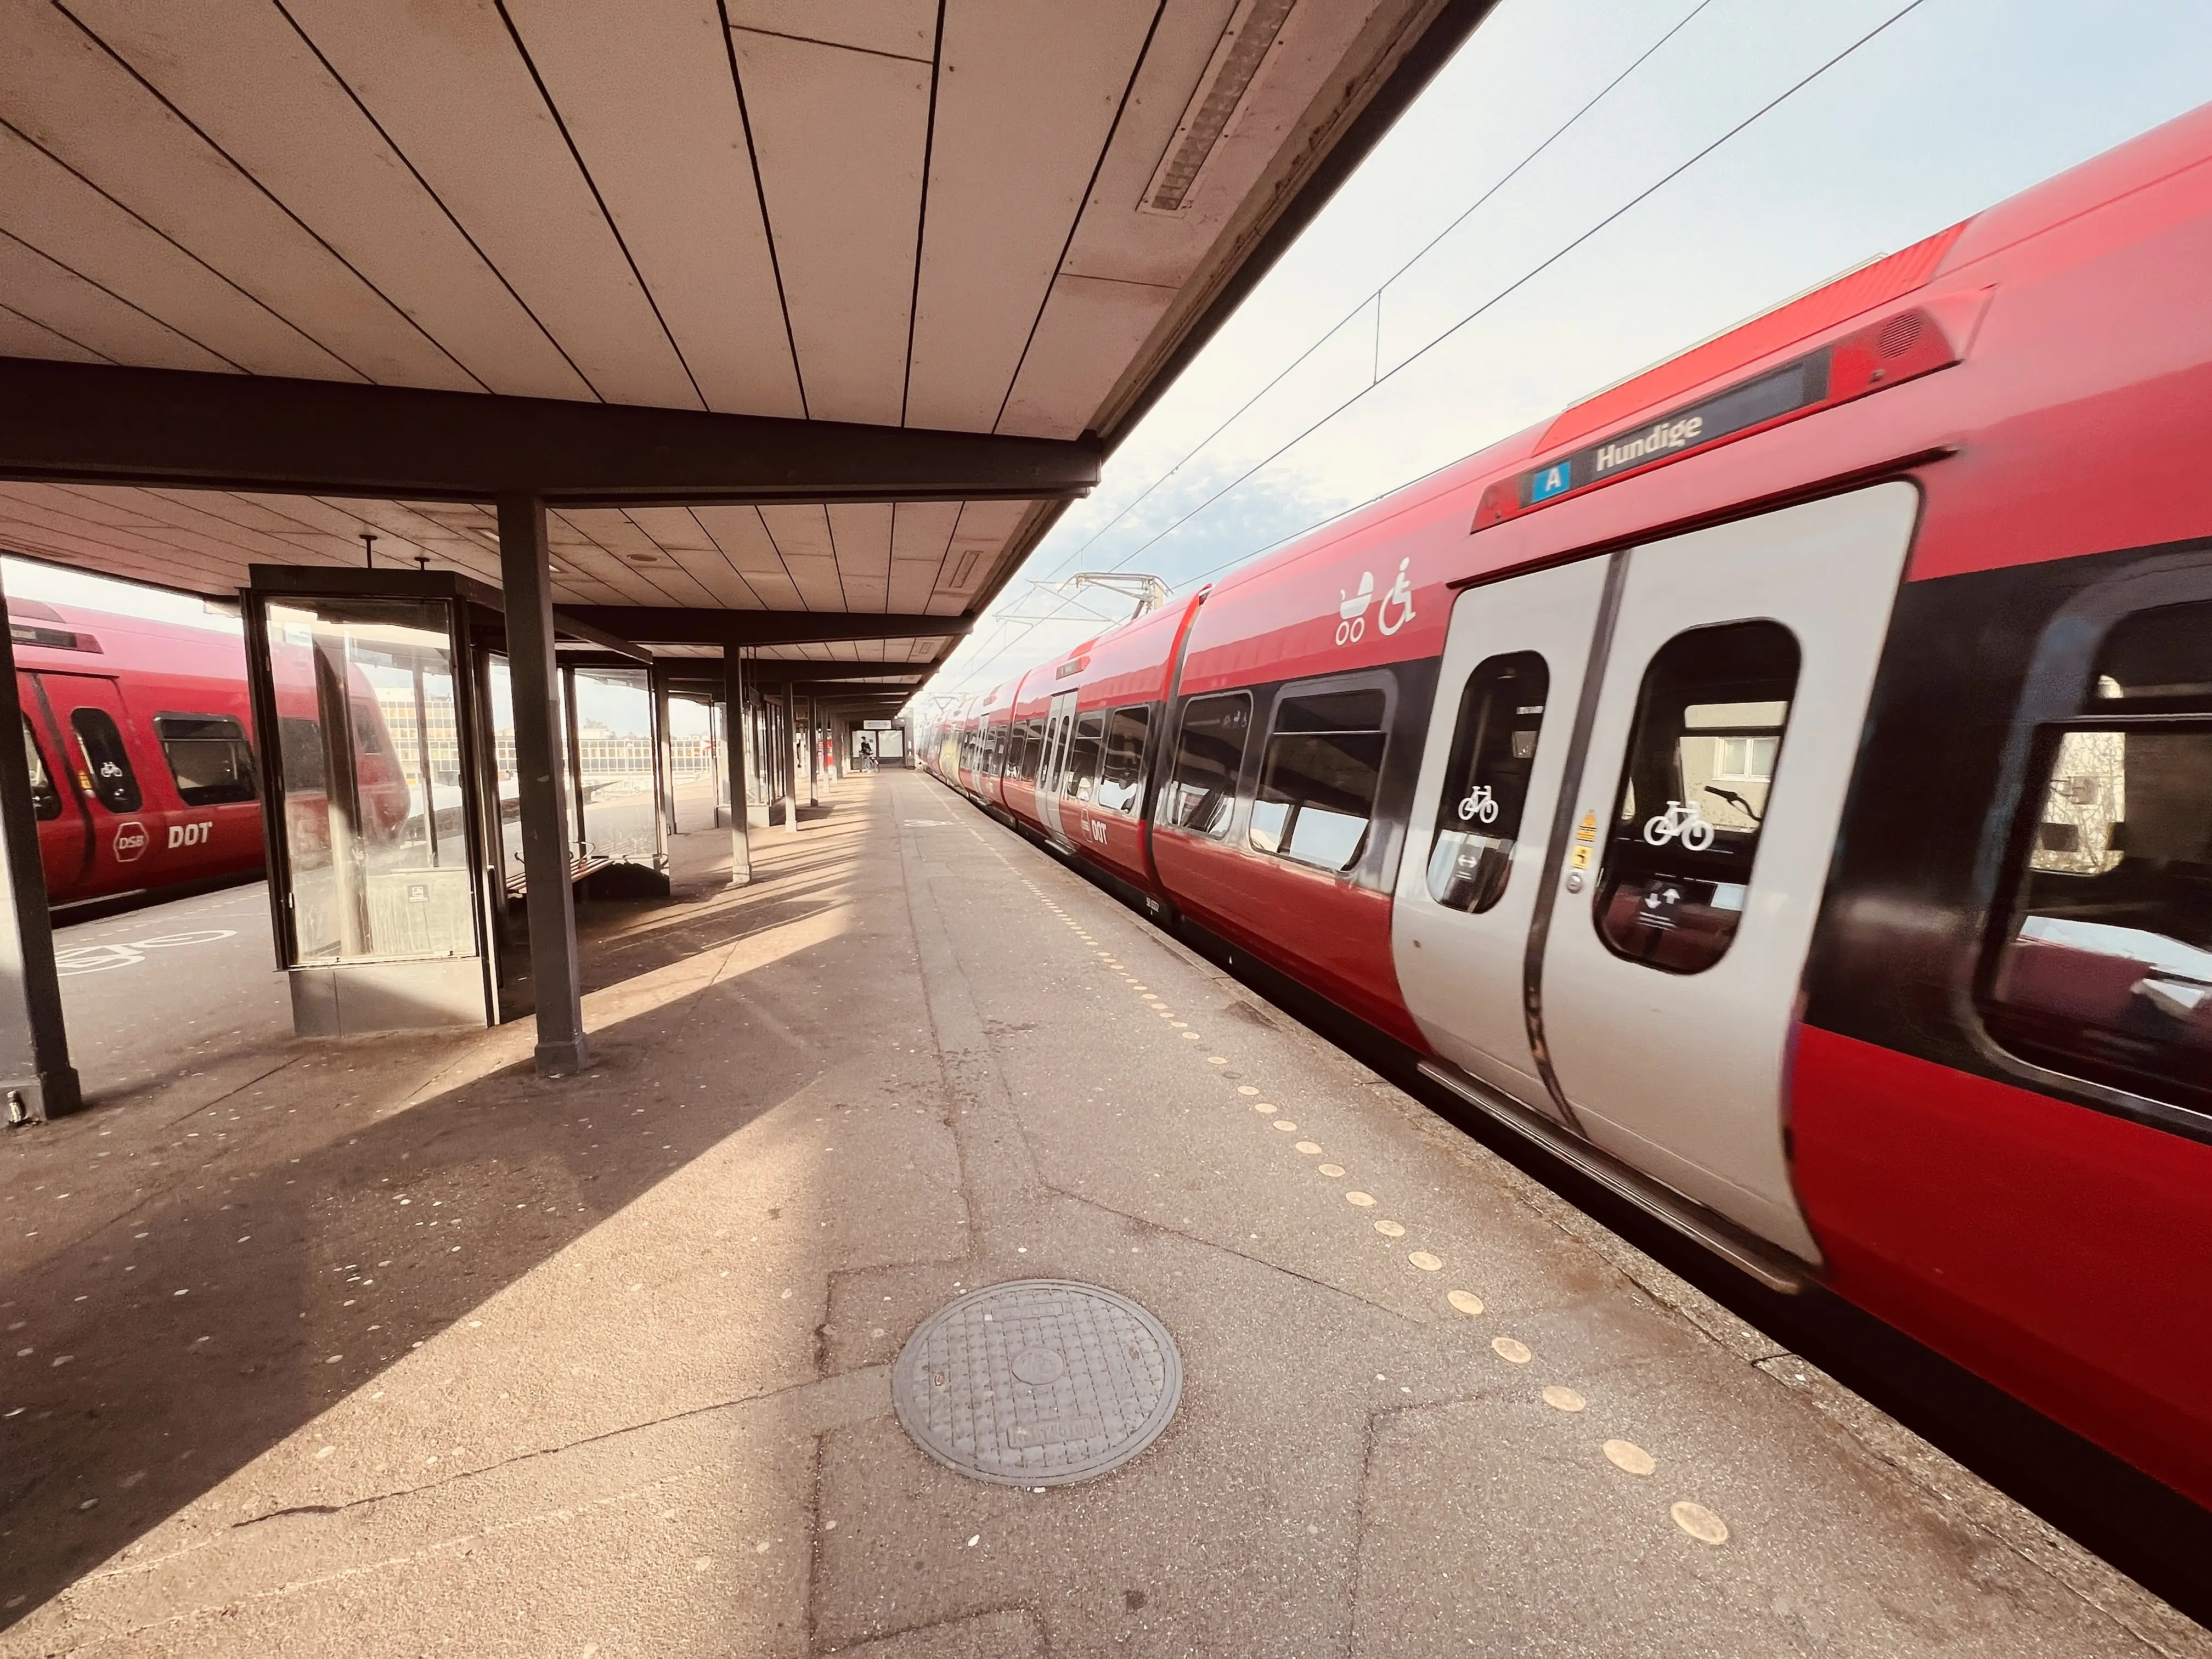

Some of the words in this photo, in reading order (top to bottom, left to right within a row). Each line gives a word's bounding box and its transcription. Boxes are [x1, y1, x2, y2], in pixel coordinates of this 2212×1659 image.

[1545, 466, 1561, 492] A
[1596, 416, 1703, 472] Hundige
[119, 836, 144, 849] DSB
[168, 821, 213, 849] DOT
[1091, 819, 1108, 845] DOT
